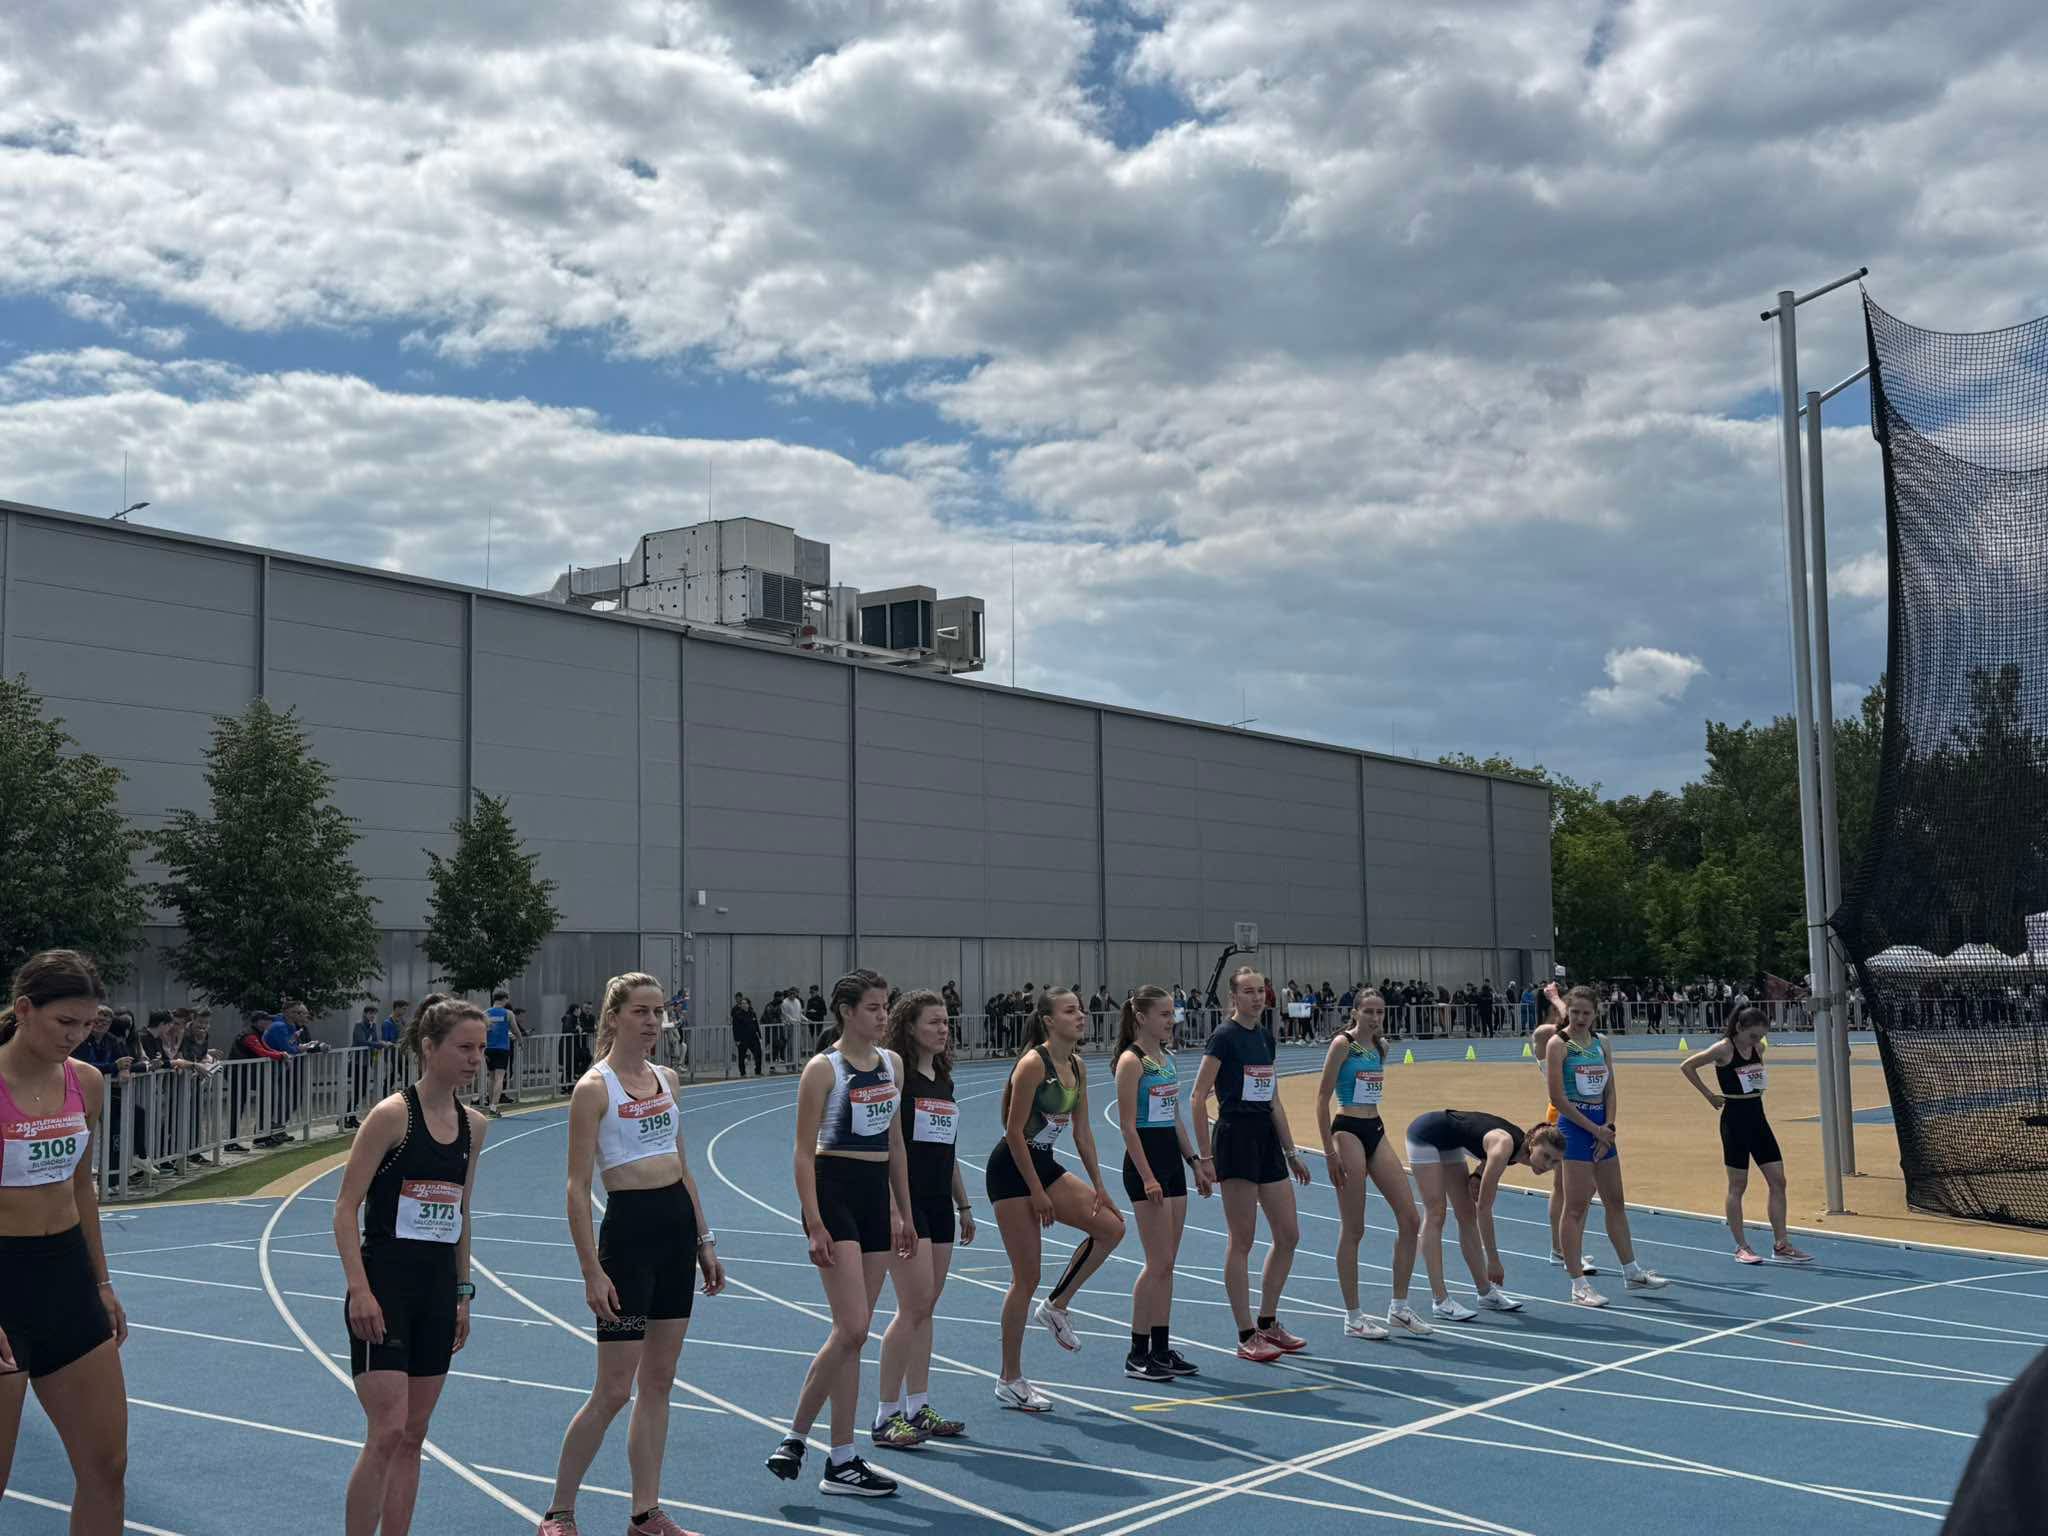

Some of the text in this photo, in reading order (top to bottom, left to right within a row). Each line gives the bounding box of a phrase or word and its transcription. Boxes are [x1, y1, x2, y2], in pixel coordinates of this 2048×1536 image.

[866, 1100, 893, 1118] 3148
[640, 1112, 671, 1134] 3198
[929, 1114, 952, 1128] 3165
[28, 1136, 77, 1161] 3108
[418, 1202, 455, 1220] 3173
